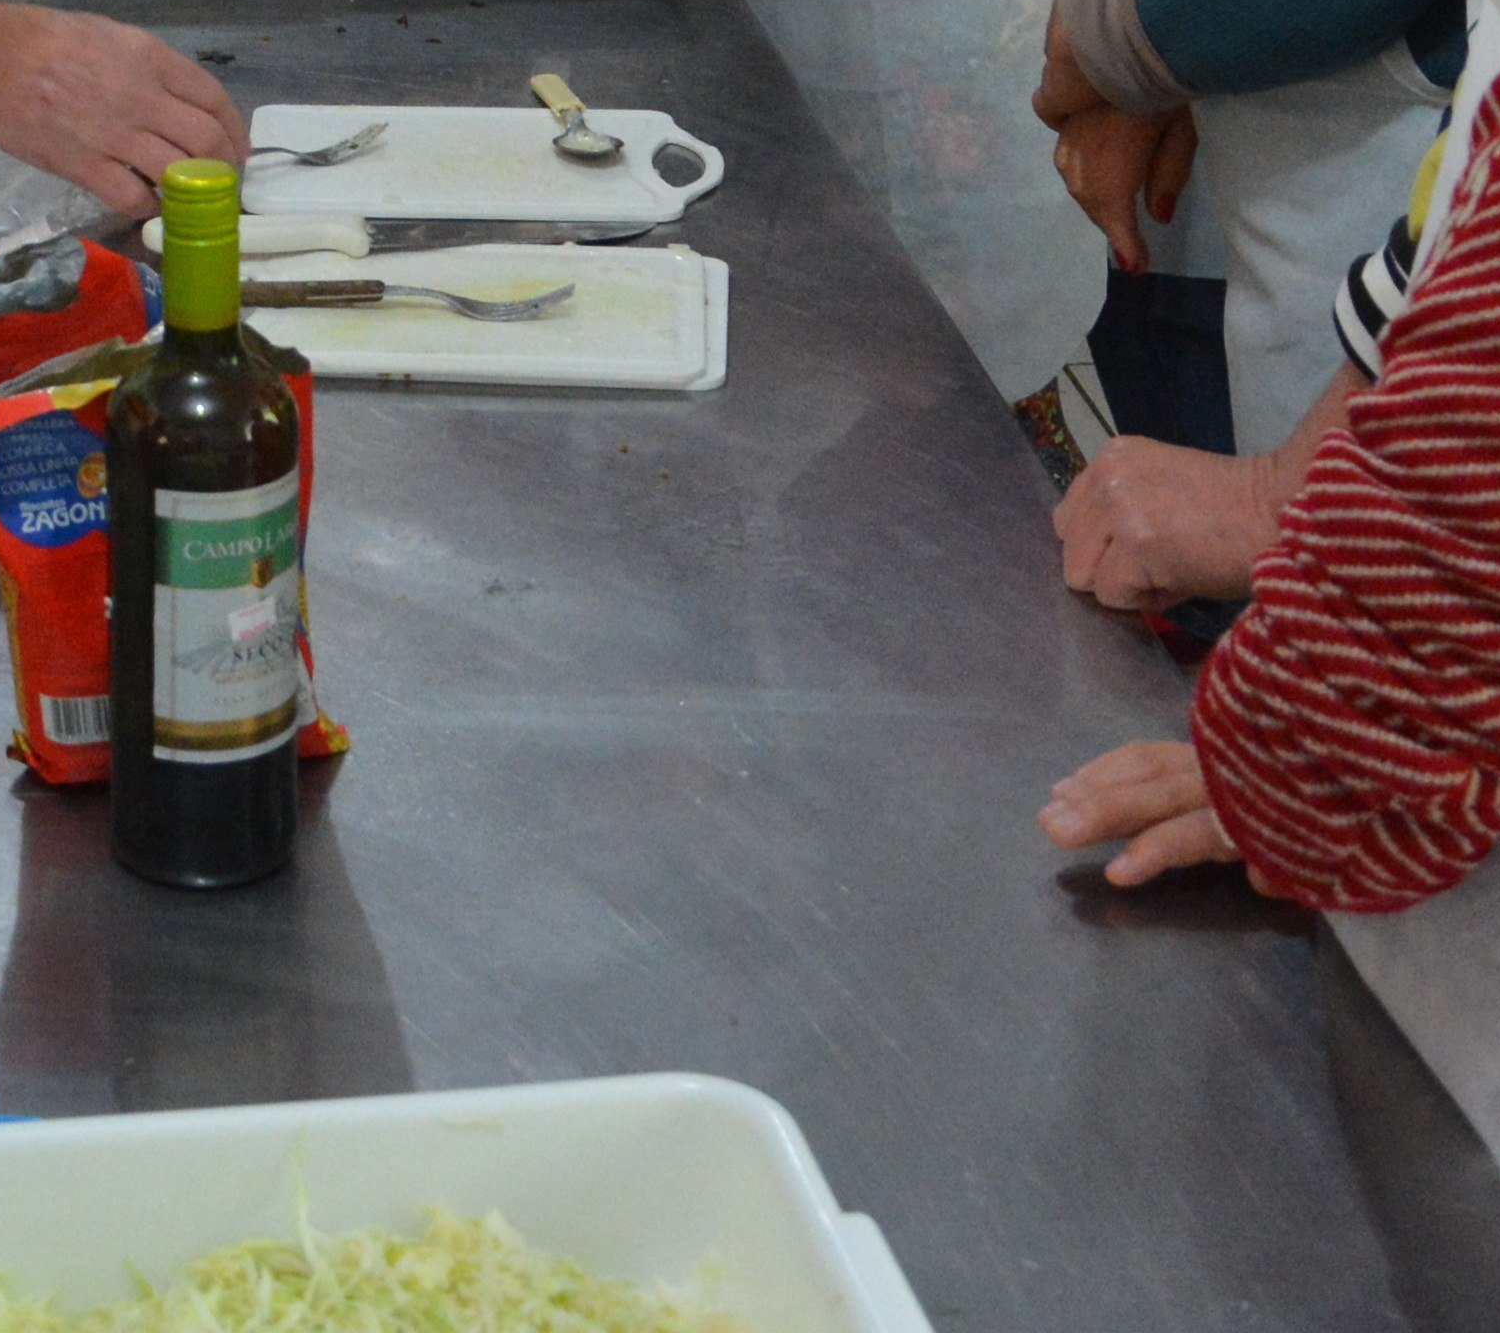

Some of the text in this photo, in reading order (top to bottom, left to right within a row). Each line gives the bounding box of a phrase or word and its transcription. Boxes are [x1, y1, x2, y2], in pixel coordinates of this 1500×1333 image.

[1, 473, 73, 496] COMPLETA
[20, 501, 106, 534] ZAGON
[184, 536, 262, 560] CAMPO
